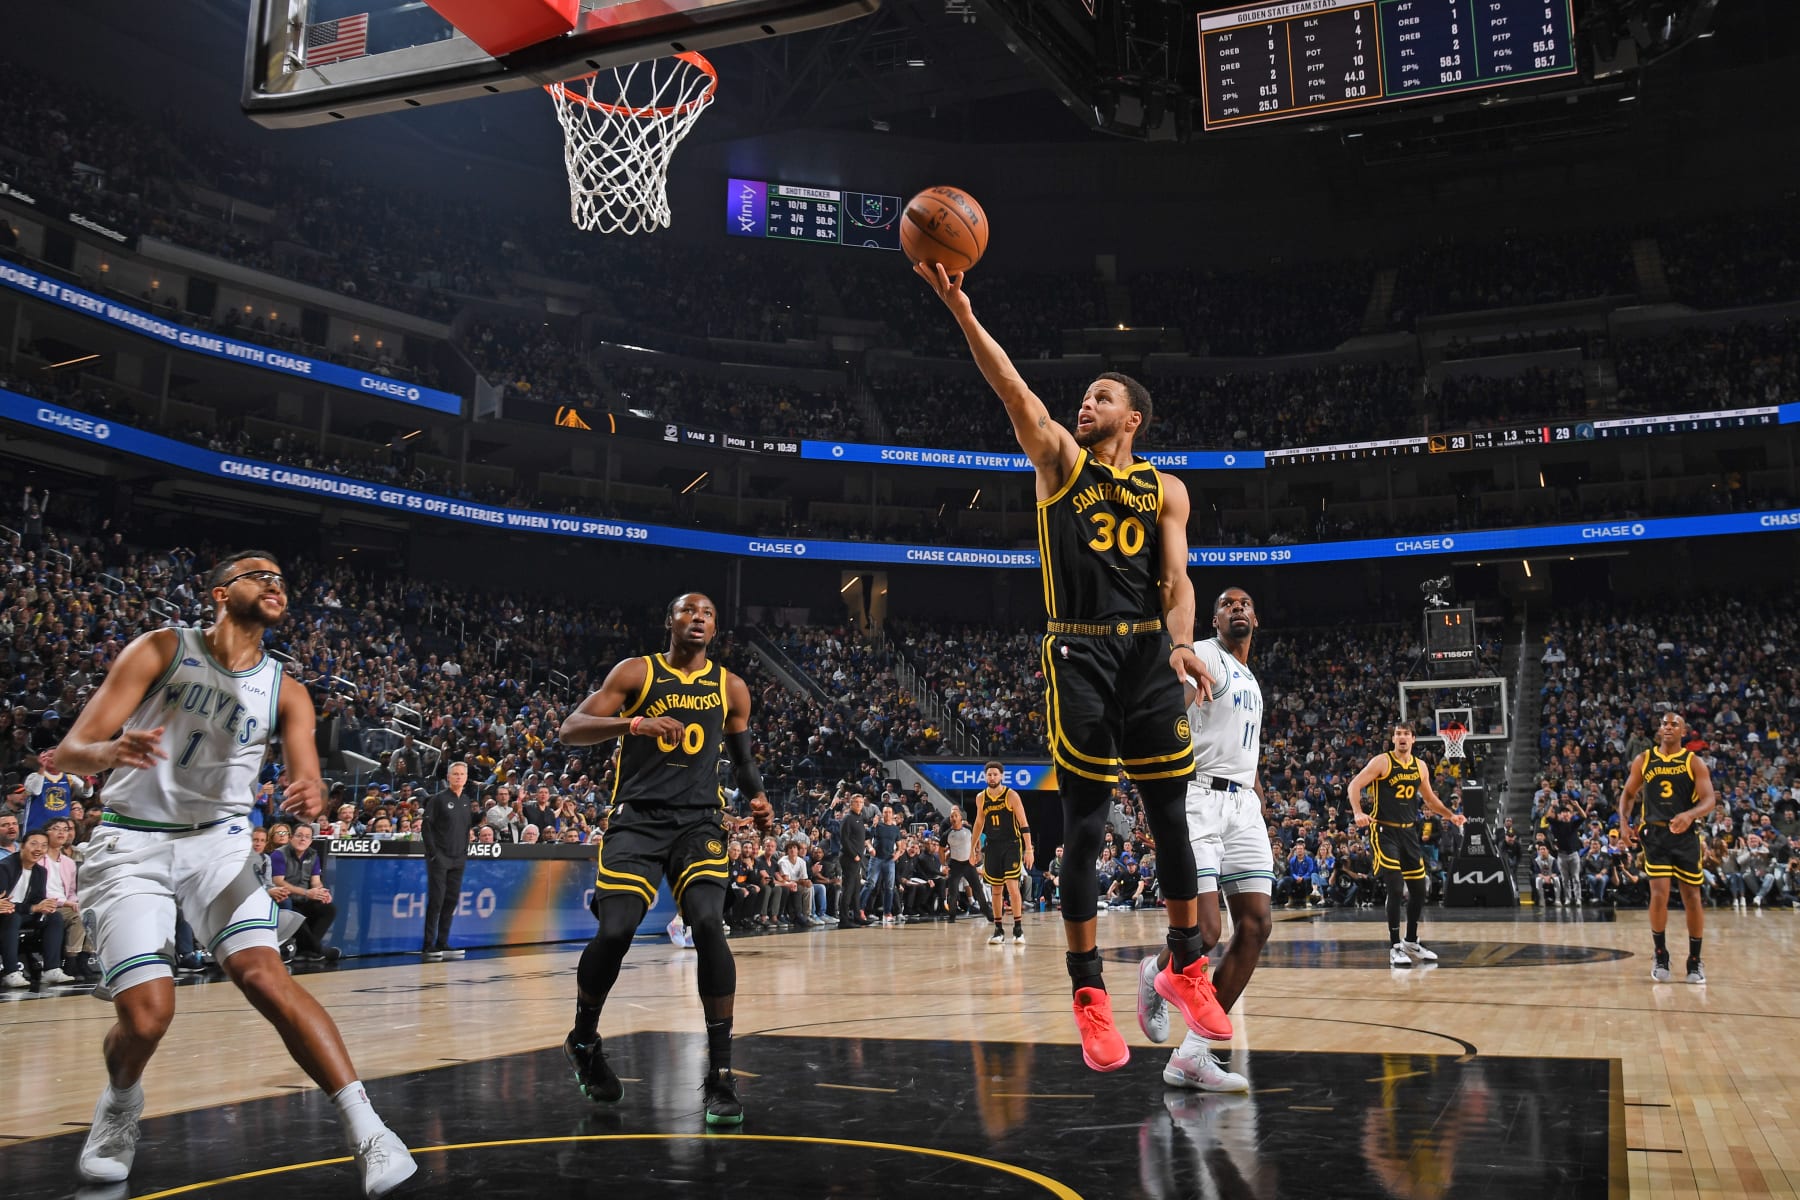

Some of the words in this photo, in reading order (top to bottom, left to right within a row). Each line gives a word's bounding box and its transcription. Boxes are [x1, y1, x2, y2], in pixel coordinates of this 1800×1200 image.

[1237, 8, 1266, 22] GOLDEN
[1267, 4, 1290, 18] STATE
[1291, 1, 1312, 14] TEAM
[1313, 0, 1337, 11] STATS
[1397, 3, 1412, 11] AST
[1489, 3, 1501, 11] TO
[1304, 19, 1319, 28] BLK
[1354, 10, 1360, 20] 0
[1398, 17, 1420, 27] OREB
[1452, 9, 1457, 19] 1
[1491, 18, 1508, 26] POT
[1545, 8, 1552, 19] 5
[1219, 34, 1233, 42] AST
[1267, 25, 1273, 35] 7
[1355, 25, 1361, 35] 4
[1399, 32, 1421, 42] DREB
[1452, 24, 1458, 35] 8
[1492, 33, 1511, 42] PITP
[1542, 24, 1553, 36] 14
[1219, 48, 1240, 57] OREB
[1268, 40, 1275, 50] 5
[1306, 49, 1321, 57] POT
[1356, 40, 1363, 51] 7
[1401, 49, 1415, 57] STL
[1453, 39, 1460, 50] 2
[1493, 49, 1513, 57] FG%
[1533, 40, 1555, 53] 55.6
[1220, 62, 1241, 72] DREB
[1269, 55, 1275, 65] 7
[1307, 63, 1325, 72] PITP
[1353, 55, 1364, 66] 10
[1402, 64, 1419, 72] 2P%
[1440, 55, 1461, 68] 58.3
[1495, 64, 1513, 73] FT%
[1535, 56, 1556, 69] 85.7
[1221, 78, 1235, 86] STL
[1270, 69, 1277, 80] 2
[1308, 79, 1326, 87] FG%
[1344, 70, 1365, 83] 44.0
[1403, 79, 1421, 88] 3P%
[1440, 70, 1462, 83] 50.0
[1222, 93, 1238, 101] 2P%
[1260, 85, 1278, 97] 61.5
[1309, 94, 1325, 102] FT%
[1345, 86, 1366, 98] 80.0
[1223, 108, 1240, 116] 3P%
[1259, 99, 1279, 112] 25.0
[785, 187, 802, 196] SHOT
[803, 189, 830, 198] TRACKER
[737, 185, 756, 232] xfinity
[790, 226, 804, 236] 6/7
[37, 281, 60, 297] AT
[60, 287, 107, 314] EVERY
[107, 304, 180, 341] WARRIORS
[179, 332, 224, 353] GAME
[225, 342, 264, 362] WITH
[266, 353, 312, 374] CHASE
[360, 377, 406, 398] CHASE
[37, 408, 94, 435] CHASE
[687, 431, 705, 440] VAN
[709, 434, 715, 443] 3
[727, 438, 746, 446] MON
[750, 440, 755, 449] 1
[764, 442, 774, 450] P3
[1503, 430, 1517, 441] 1.3
[1556, 427, 1570, 439] 29
[1452, 437, 1465, 449] 29
[881, 449, 919, 462] SCORE
[921, 451, 956, 464] MORE
[957, 454, 973, 465] AT
[975, 455, 1011, 467] EVERY
[1150, 456, 1188, 466] CHASE
[220, 460, 270, 481] CHASE
[271, 470, 377, 500] CARDHOLDERS:
[380, 491, 405, 505] GET
[407, 495, 422, 509] $5
[424, 498, 448, 514] OFF
[450, 503, 505, 523] EATERIES
[507, 513, 549, 530] WHEN
[551, 518, 580, 532] YOU
[582, 522, 624, 537] SPEND
[626, 527, 648, 540] $30
[1072, 485, 1101, 513] SAN
[1088, 512, 1145, 557] 30
[1582, 525, 1630, 538] CHASE
[749, 541, 793, 554] CHASE
[1395, 539, 1440, 552] CHASE
[906, 549, 945, 562] CHASE
[947, 551, 1035, 565] CARDHOLDERS:
[1201, 551, 1225, 562] YOU
[1229, 550, 1267, 562] SPEND
[1270, 549, 1291, 561] $30
[1443, 650, 1473, 658] TISSOT
[646, 698, 668, 719] SAN
[665, 692, 721, 710] FRANCISCO
[1231, 689, 1263, 714] WOLV
[164, 681, 257, 746] WOLVES
[1242, 721, 1256, 751] 11
[176, 729, 205, 769] 1
[952, 770, 1012, 784] CHAE
[1395, 784, 1415, 799] 20
[1660, 780, 1673, 798] 3
[991, 815, 1000, 826] 11
[1467, 816, 1485, 824] finity
[330, 839, 369, 853] CHASE
[467, 843, 491, 856] ASE
[1453, 870, 1504, 884] KIA
[392, 891, 473, 918] CHE
